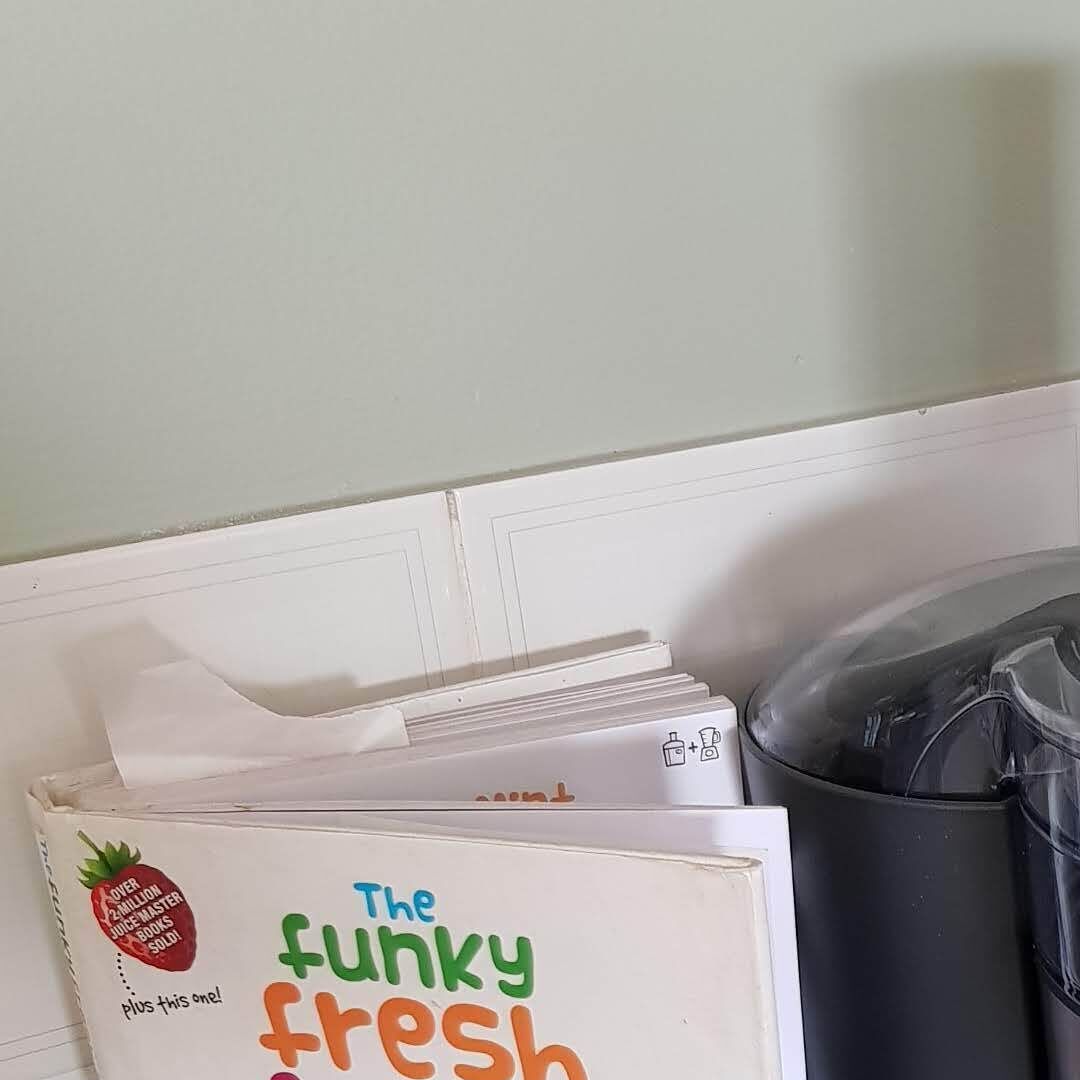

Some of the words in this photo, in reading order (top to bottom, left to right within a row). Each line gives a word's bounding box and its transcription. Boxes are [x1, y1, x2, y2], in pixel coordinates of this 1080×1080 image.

[110, 877, 141, 901] OVER
[117, 884, 163, 917] MILLION
[354, 882, 436, 922] The
[110, 917, 140, 940] JUICE
[138, 891, 184, 923] MASTER
[136, 915, 174, 943] BOOKS
[148, 930, 182, 954] SOLD!
[279, 913, 534, 998] funky
[122, 998, 154, 1020] plus
[157, 994, 190, 1015] this
[192, 986, 222, 1004] one!
